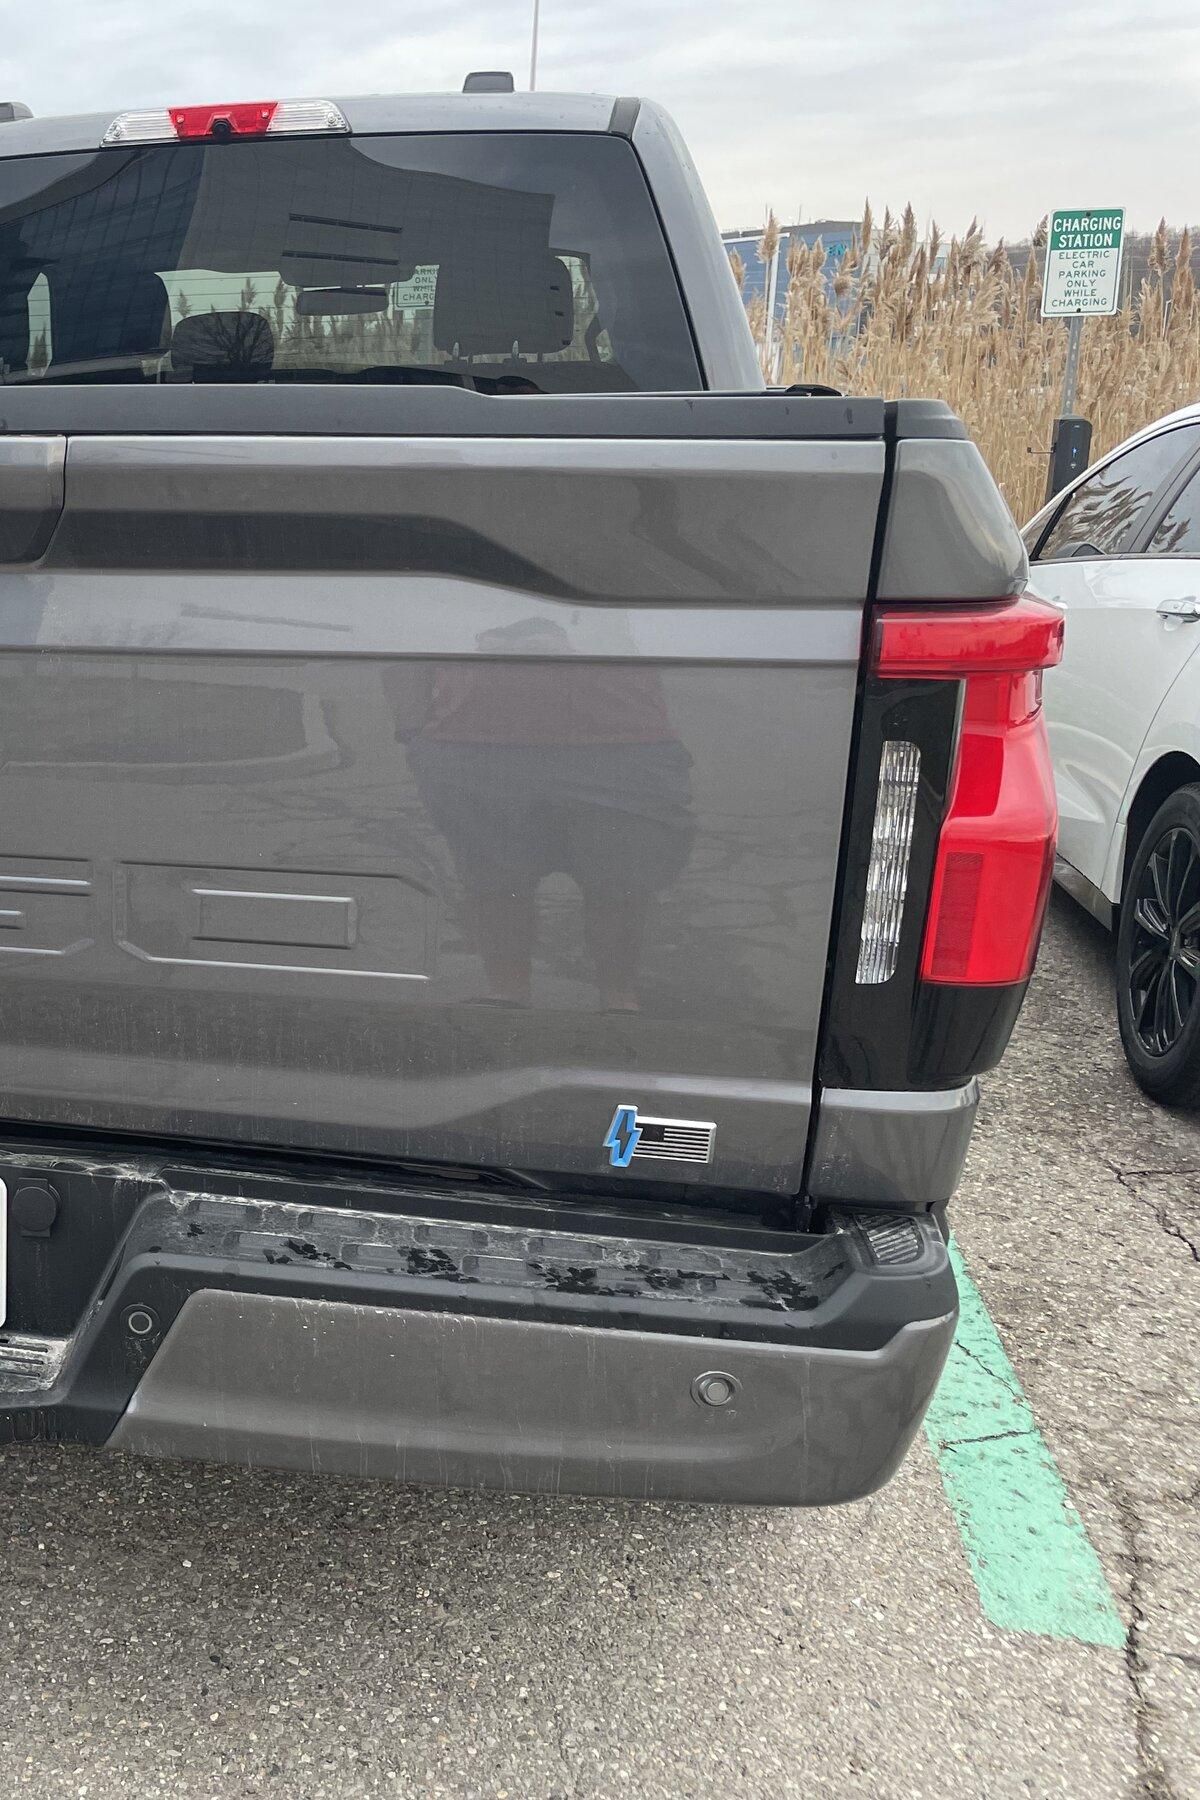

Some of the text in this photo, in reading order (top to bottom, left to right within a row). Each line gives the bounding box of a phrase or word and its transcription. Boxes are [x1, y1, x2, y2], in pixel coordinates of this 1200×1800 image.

[1053, 216, 1122, 232] CHARGING
[1058, 233, 1113, 248] STATION
[1059, 250, 1110, 260] ELECTRIC
[1072, 260, 1095, 269] CAR
[1058, 269, 1106, 279] PARKING
[414, 276, 437, 284] ONL
[1066, 279, 1096, 288] ONLY
[402, 292, 435, 301] CHARG
[1063, 288, 1097, 297] WHILE
[1051, 297, 1107, 307] CHARGING
